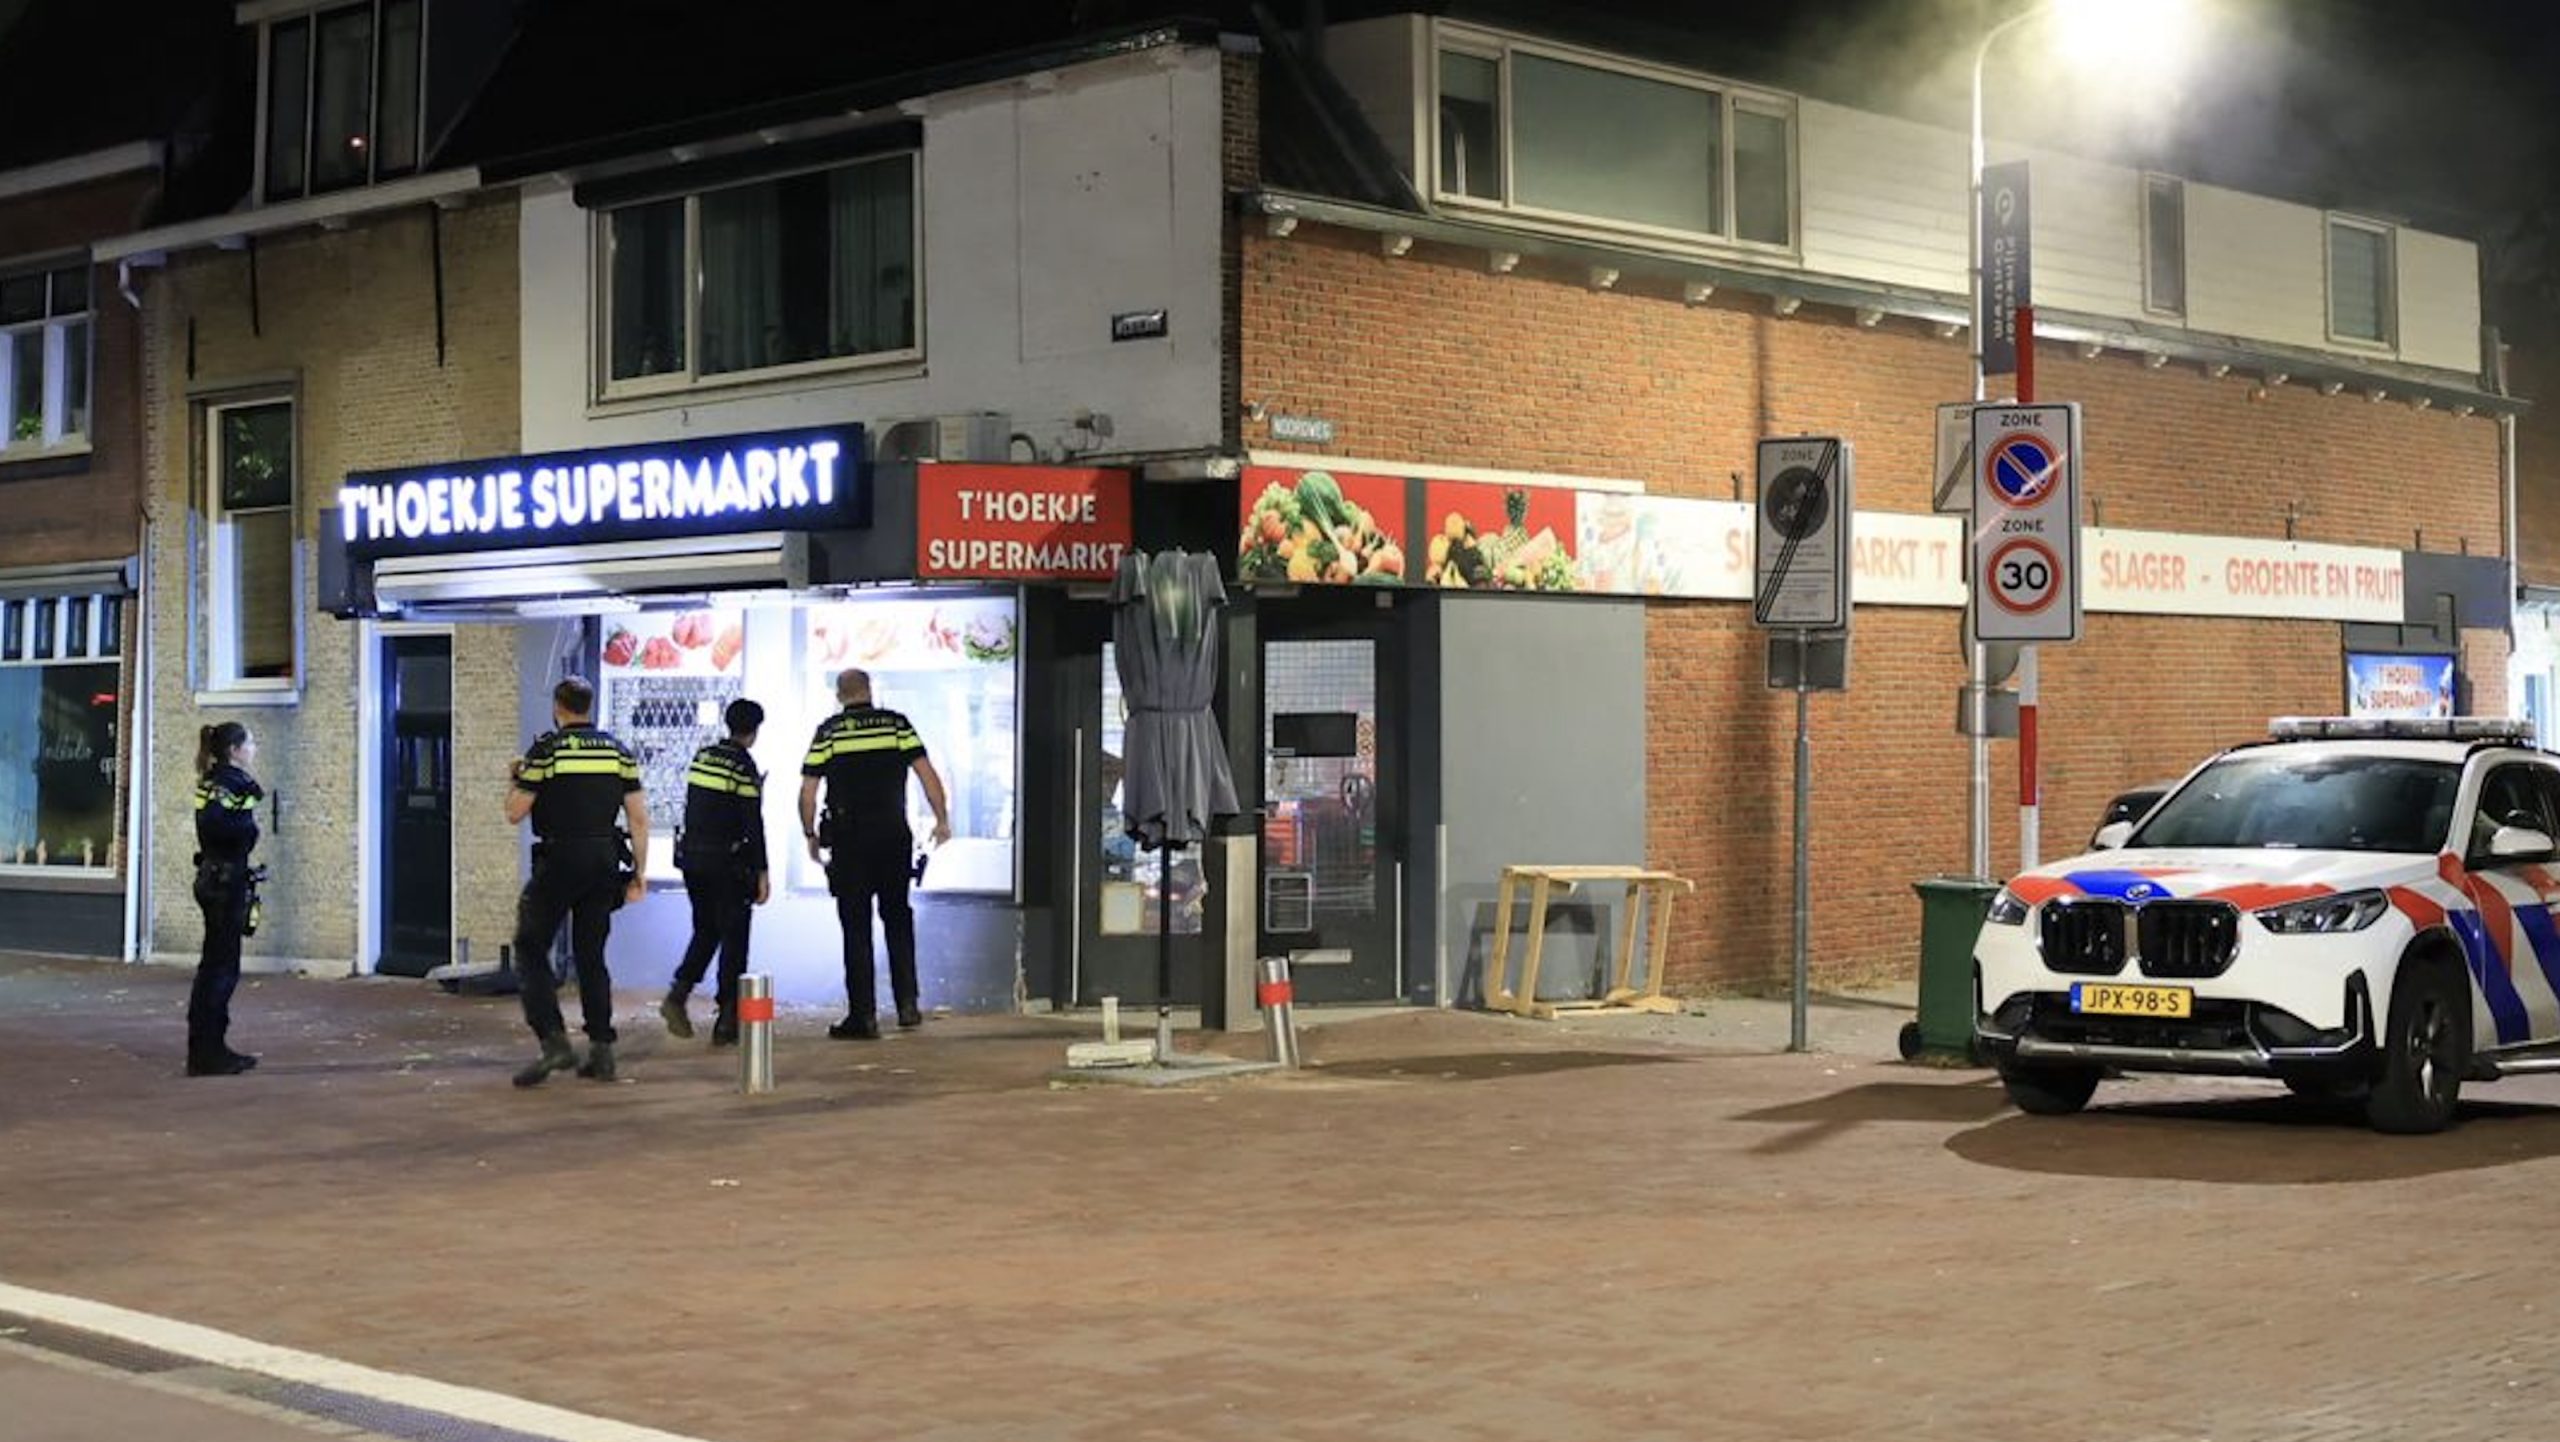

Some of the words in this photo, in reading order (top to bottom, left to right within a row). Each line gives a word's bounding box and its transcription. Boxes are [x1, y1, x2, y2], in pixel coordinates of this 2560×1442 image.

[2001, 413, 2042, 427] ZONE
[1781, 450, 1814, 462] ZONE
[339, 471, 525, 541] T'HOEKJE
[530, 441, 840, 529] SUPERMARKT
[957, 490, 1097, 523] T'HOEKJE
[2002, 519, 2044, 533] ZONE
[928, 538, 1124, 571] SUPERMARKT
[2002, 561, 2048, 591] 30
[2100, 550, 2186, 591] SLAGER
[2225, 557, 2319, 597] GROENTE
[2326, 563, 2349, 599] EN
[2355, 564, 2402, 603] FRUIT
[2087, 988, 2179, 1012] JPX-98-S
